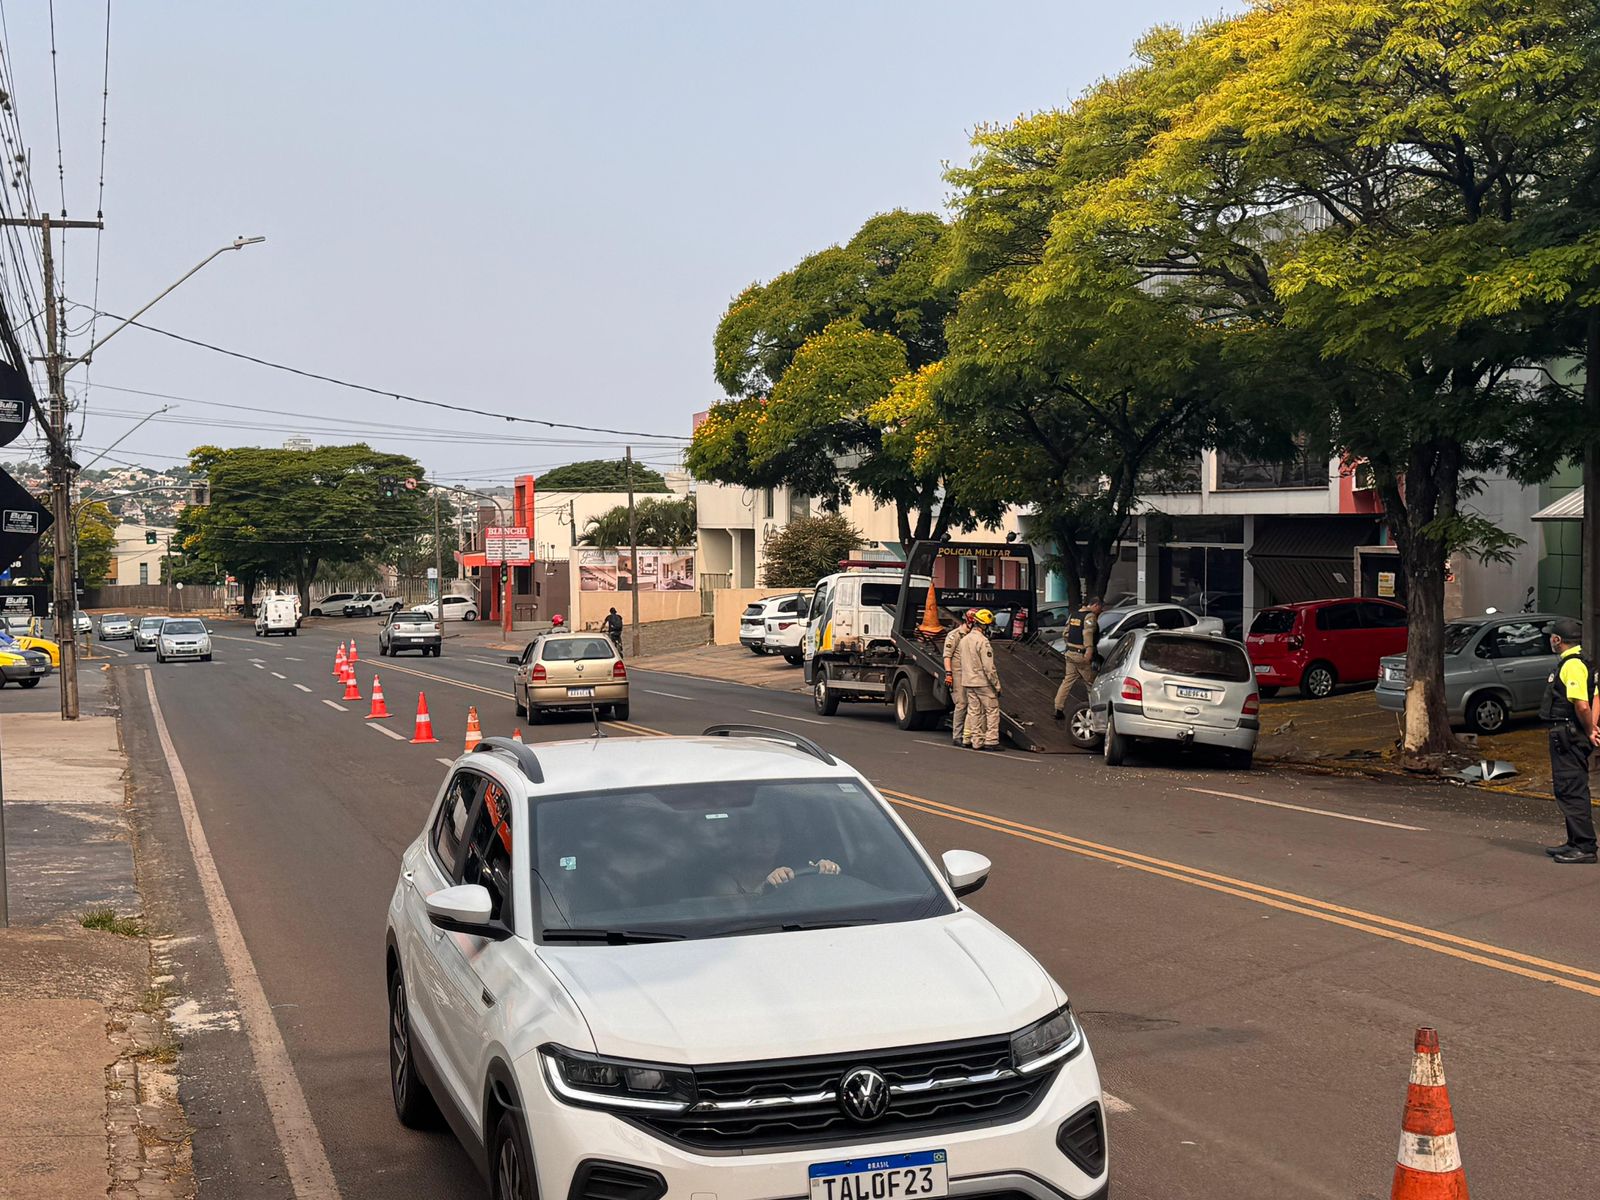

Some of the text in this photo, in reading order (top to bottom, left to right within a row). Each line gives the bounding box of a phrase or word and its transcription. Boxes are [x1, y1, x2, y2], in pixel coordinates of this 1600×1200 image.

[10, 512, 33, 520] Bulla
[488, 526, 528, 535] BIANCHI
[975, 549, 1011, 558] MILITAR
[867, 1161, 889, 1170] BRASIL
